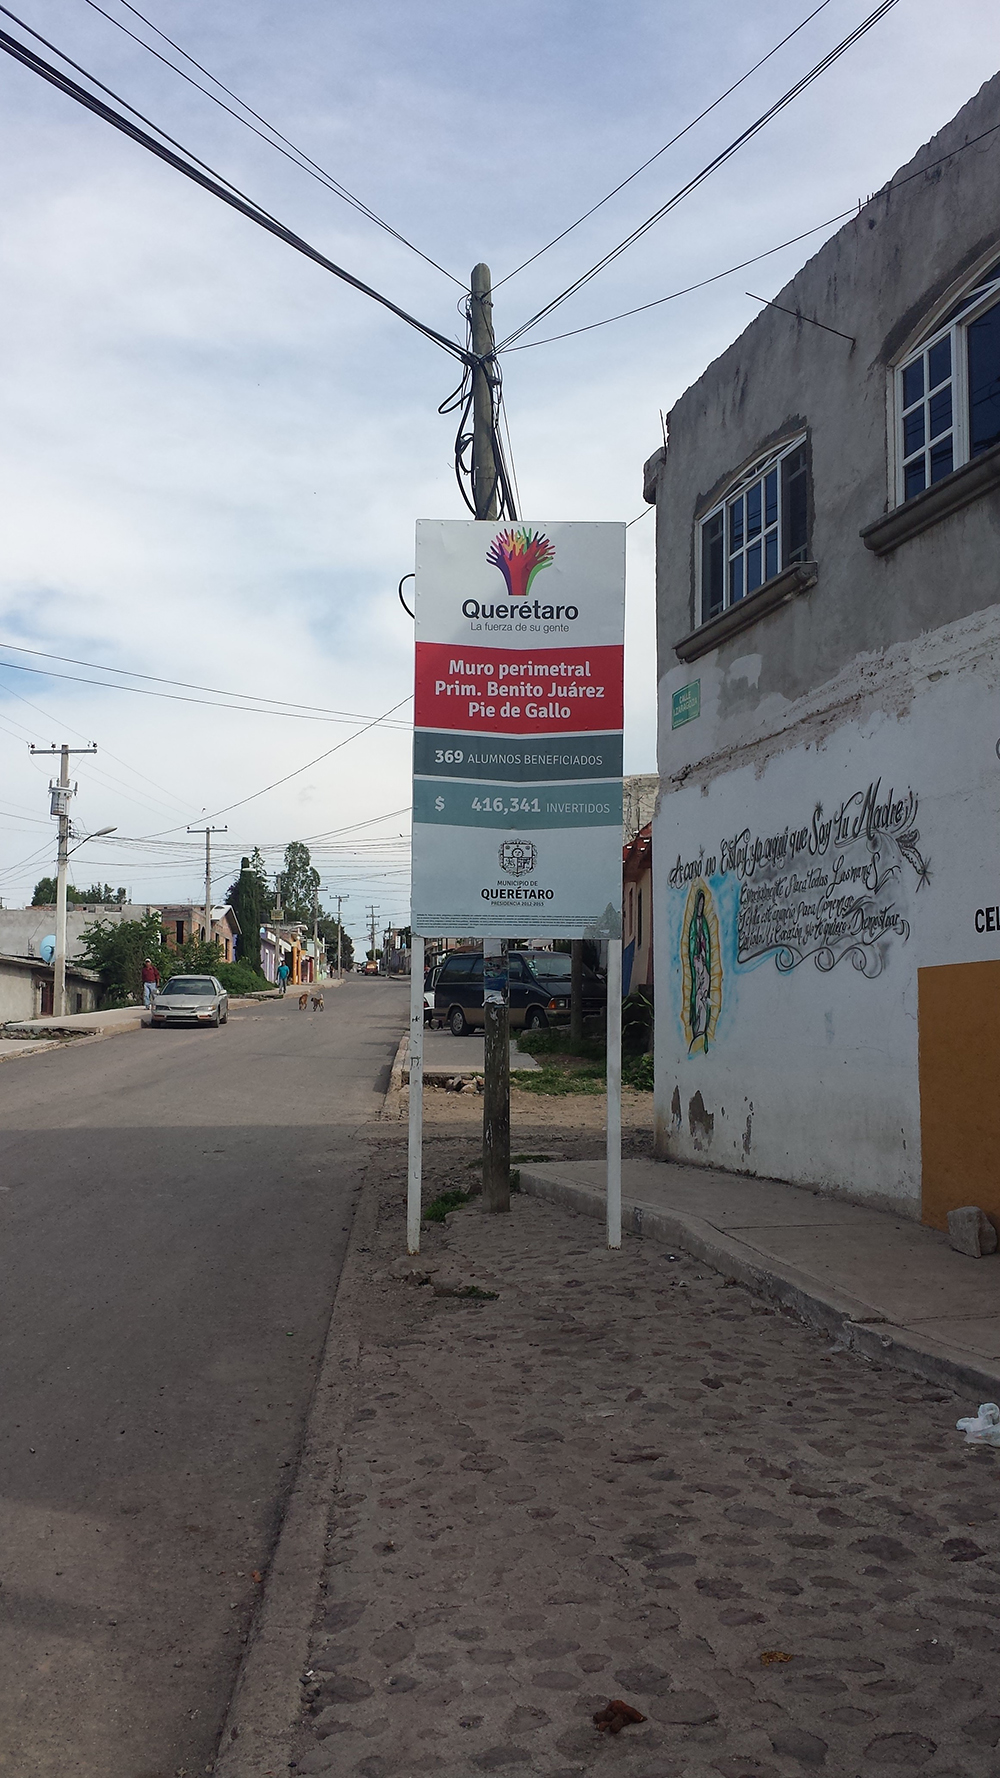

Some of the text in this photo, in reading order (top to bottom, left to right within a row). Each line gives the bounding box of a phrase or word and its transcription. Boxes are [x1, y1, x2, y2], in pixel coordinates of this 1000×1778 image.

[461, 599, 579, 620] Querétaro
[470, 622, 570, 634] La fuerza de su gente
[449, 659, 591, 680] Muro perimetral
[435, 680, 605, 698] Prim. Benito Juárez
[468, 702, 571, 719] Pie de Gallo
[434, 750, 603, 766] 369 ALUMNOS BENEFICIADOS
[434, 796, 610, 815] $ 416,341 INVERTIDOS
[481, 886, 554, 901] QUERÉTARO
